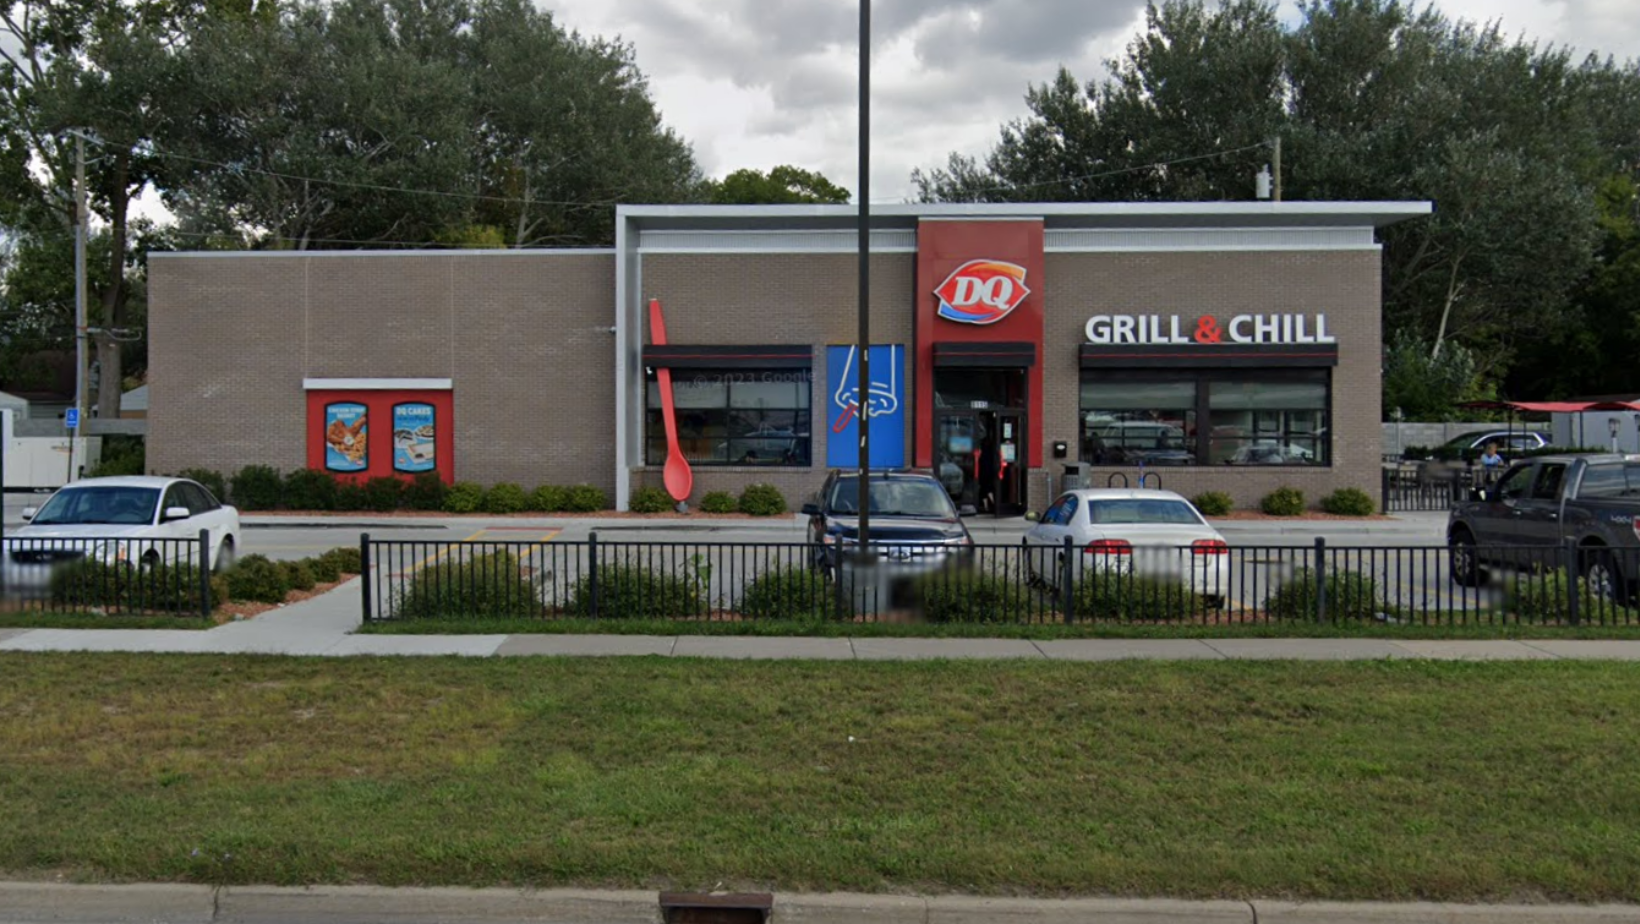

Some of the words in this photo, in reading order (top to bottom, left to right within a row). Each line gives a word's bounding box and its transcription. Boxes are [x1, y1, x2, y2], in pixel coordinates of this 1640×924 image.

[951, 275, 1013, 310] DQ
[1085, 315, 1190, 343] GRILL
[1193, 315, 1222, 344] &
[1228, 314, 1336, 343] CHILL
